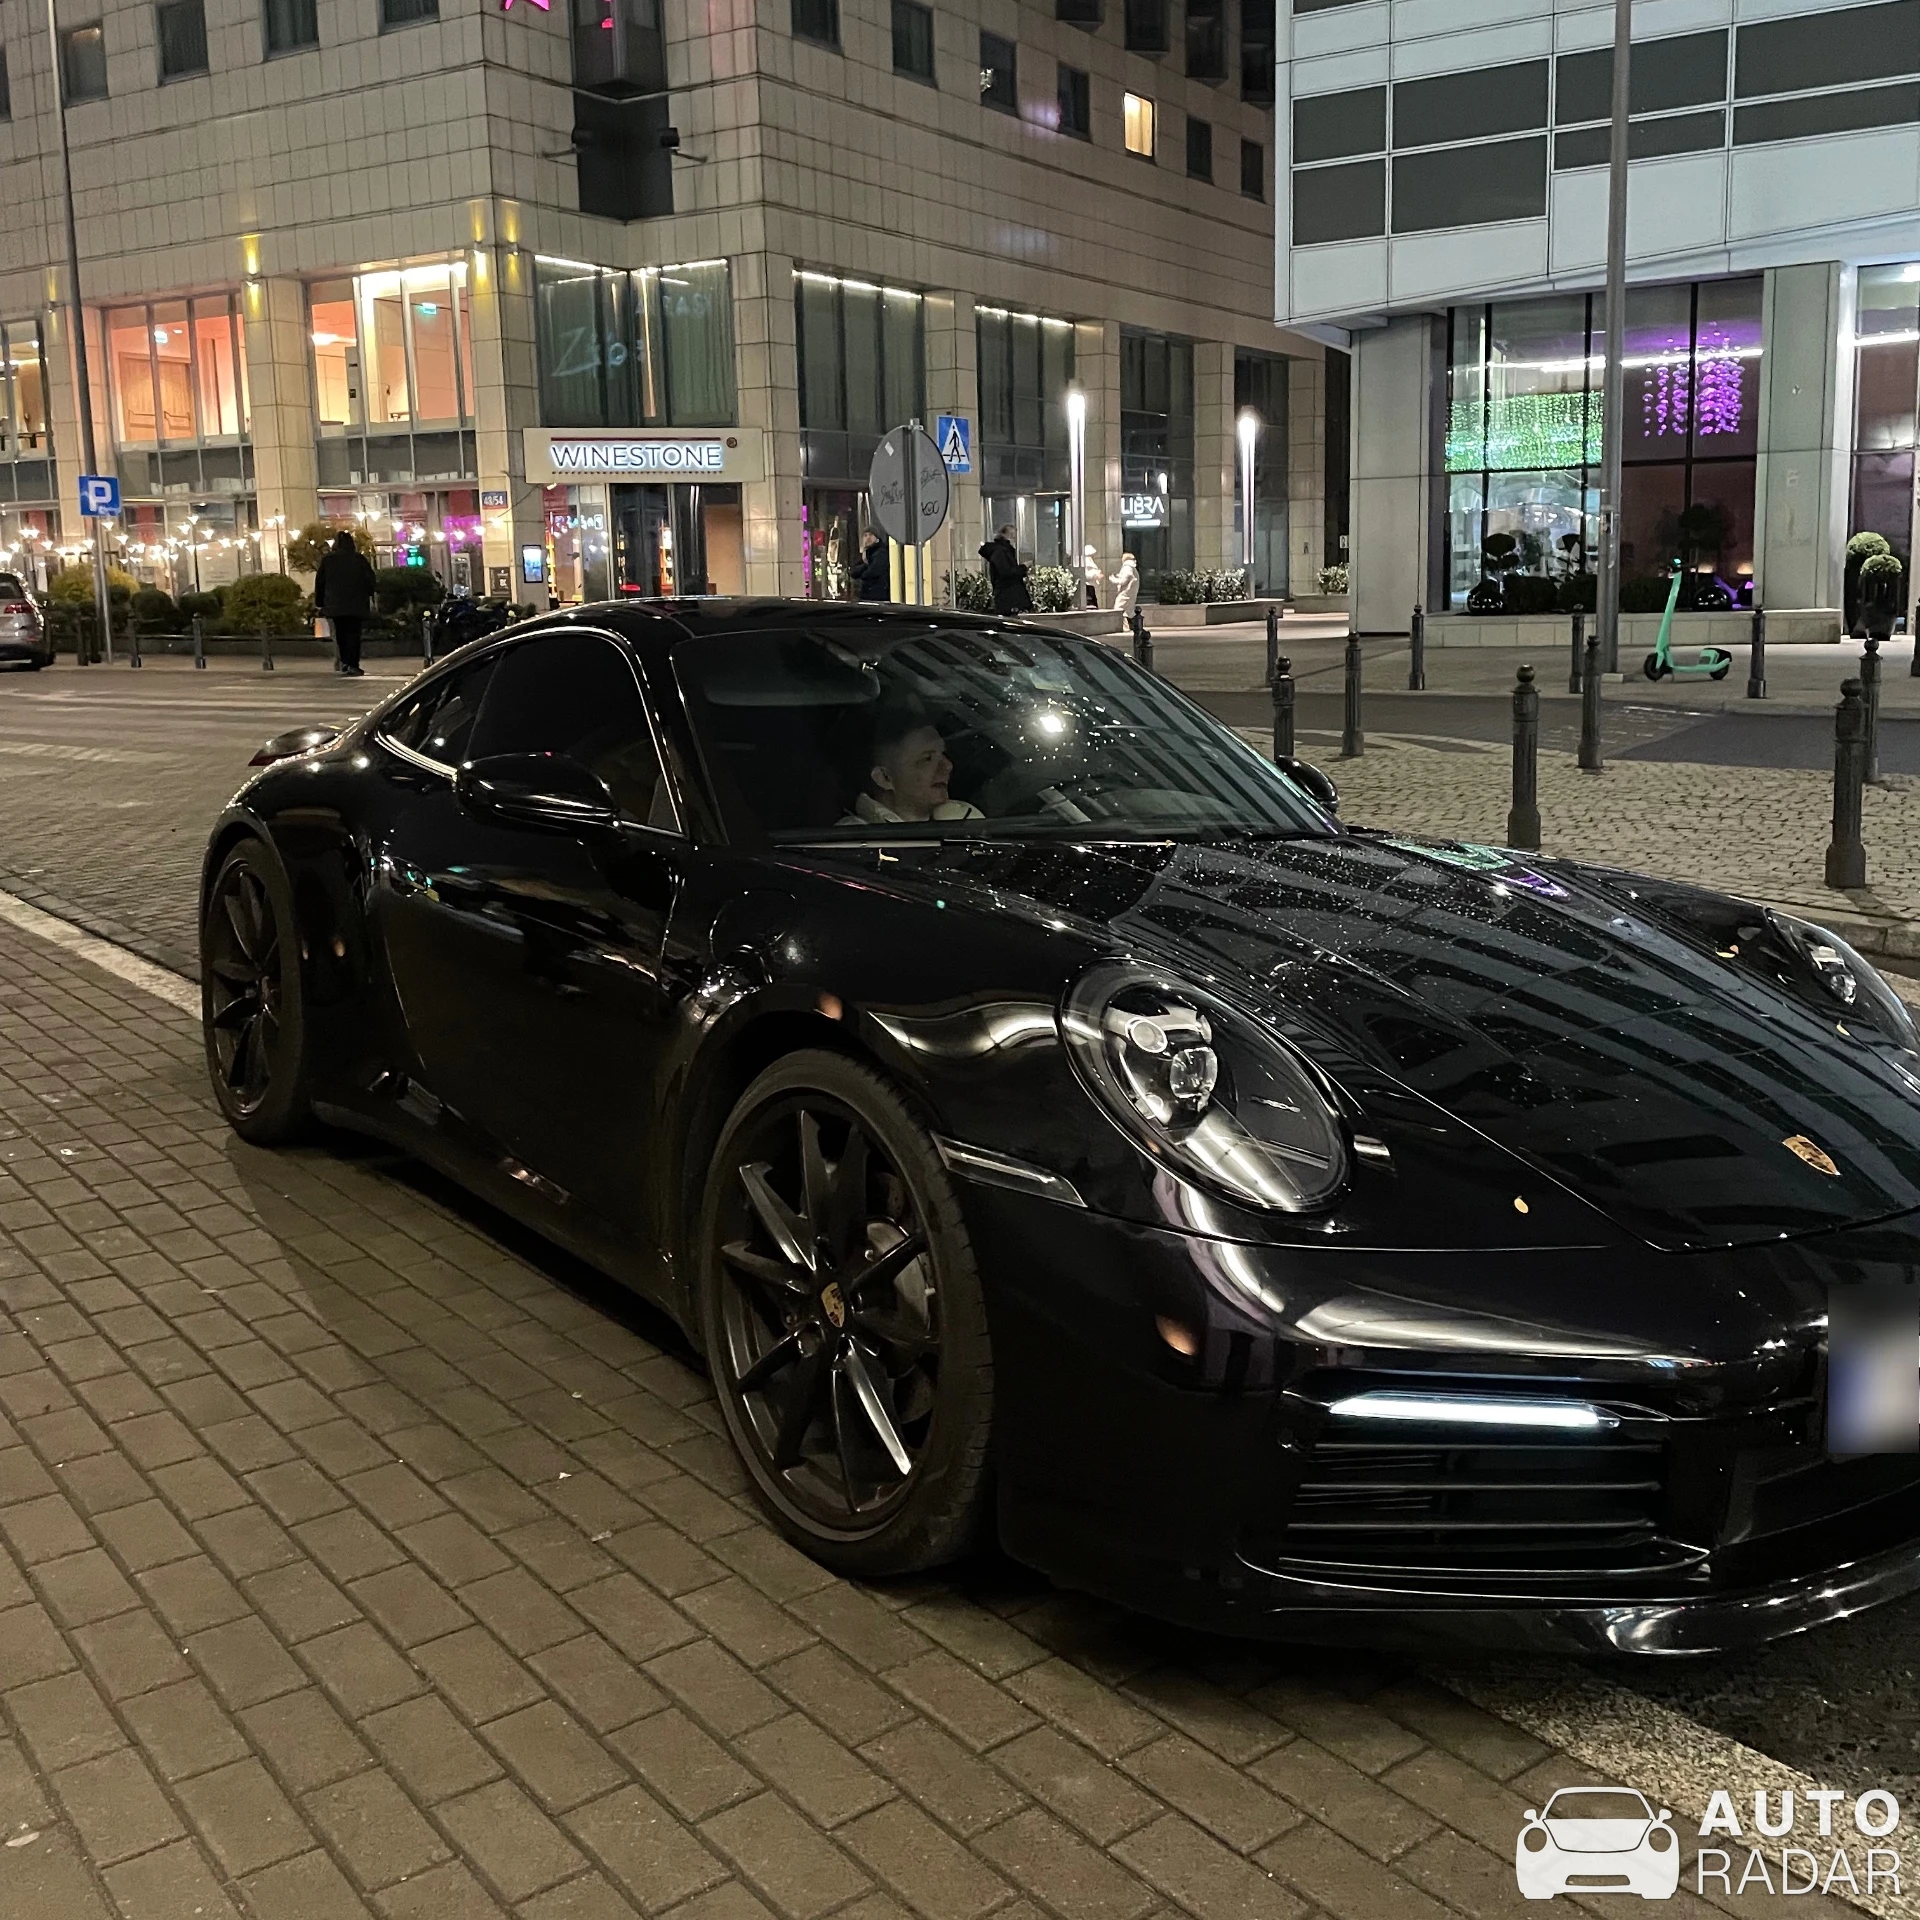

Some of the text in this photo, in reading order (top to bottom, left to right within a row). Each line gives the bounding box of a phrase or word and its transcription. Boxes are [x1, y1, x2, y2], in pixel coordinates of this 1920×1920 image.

[551, 446, 722, 467] WINESTONE
[88, 480, 112, 512] P
[1121, 496, 1165, 514] LIBRA
